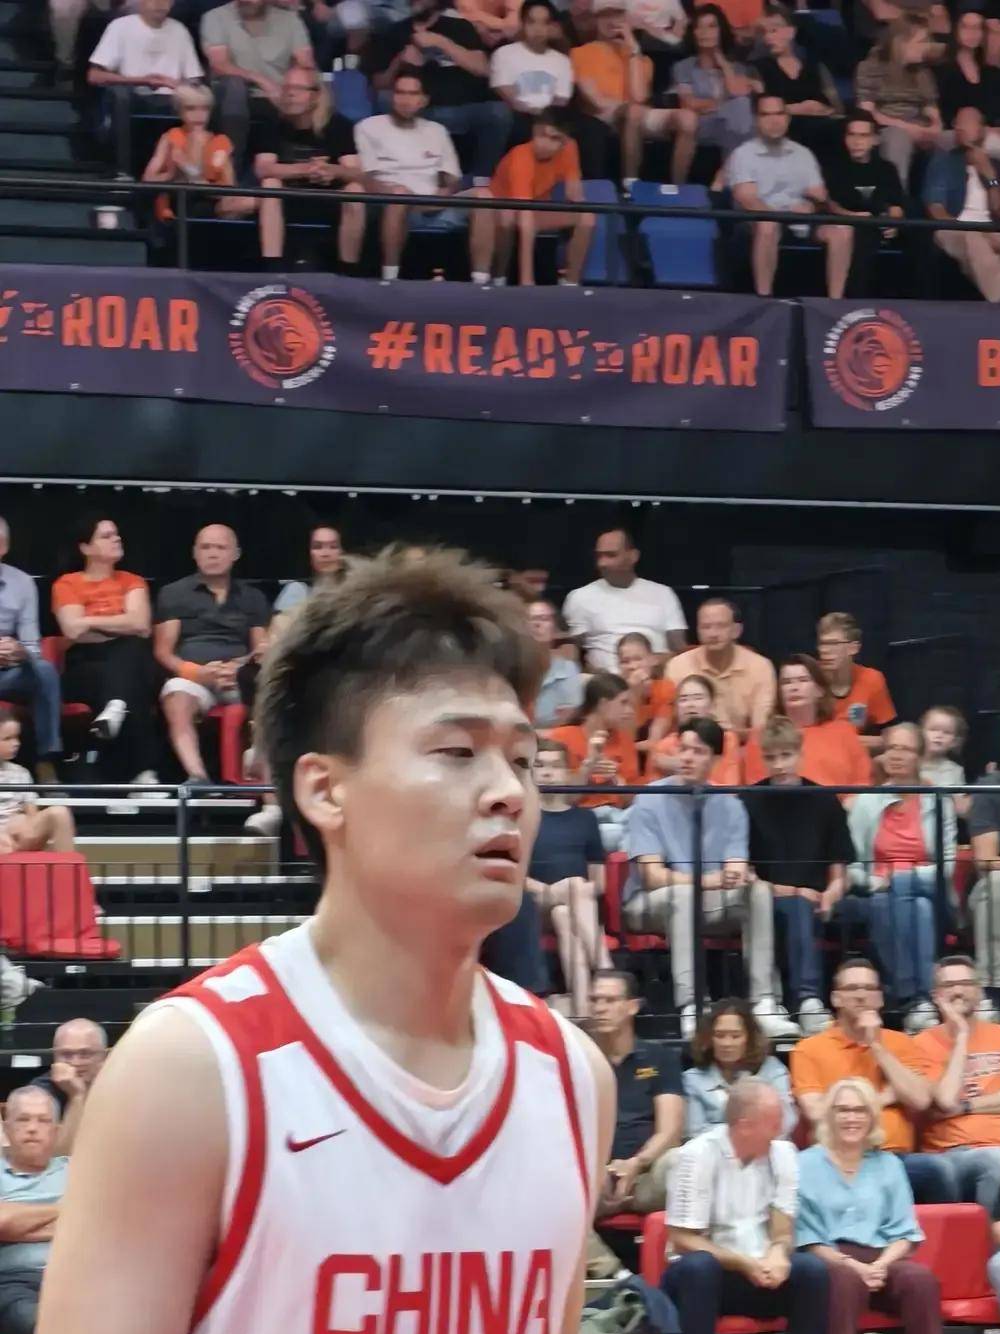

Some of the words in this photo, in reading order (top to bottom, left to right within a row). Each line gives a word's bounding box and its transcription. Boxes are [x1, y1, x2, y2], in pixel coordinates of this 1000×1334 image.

[61, 293, 200, 352] ROAR
[367, 320, 591, 380] #READY
[631, 332, 760, 387] ROAR
